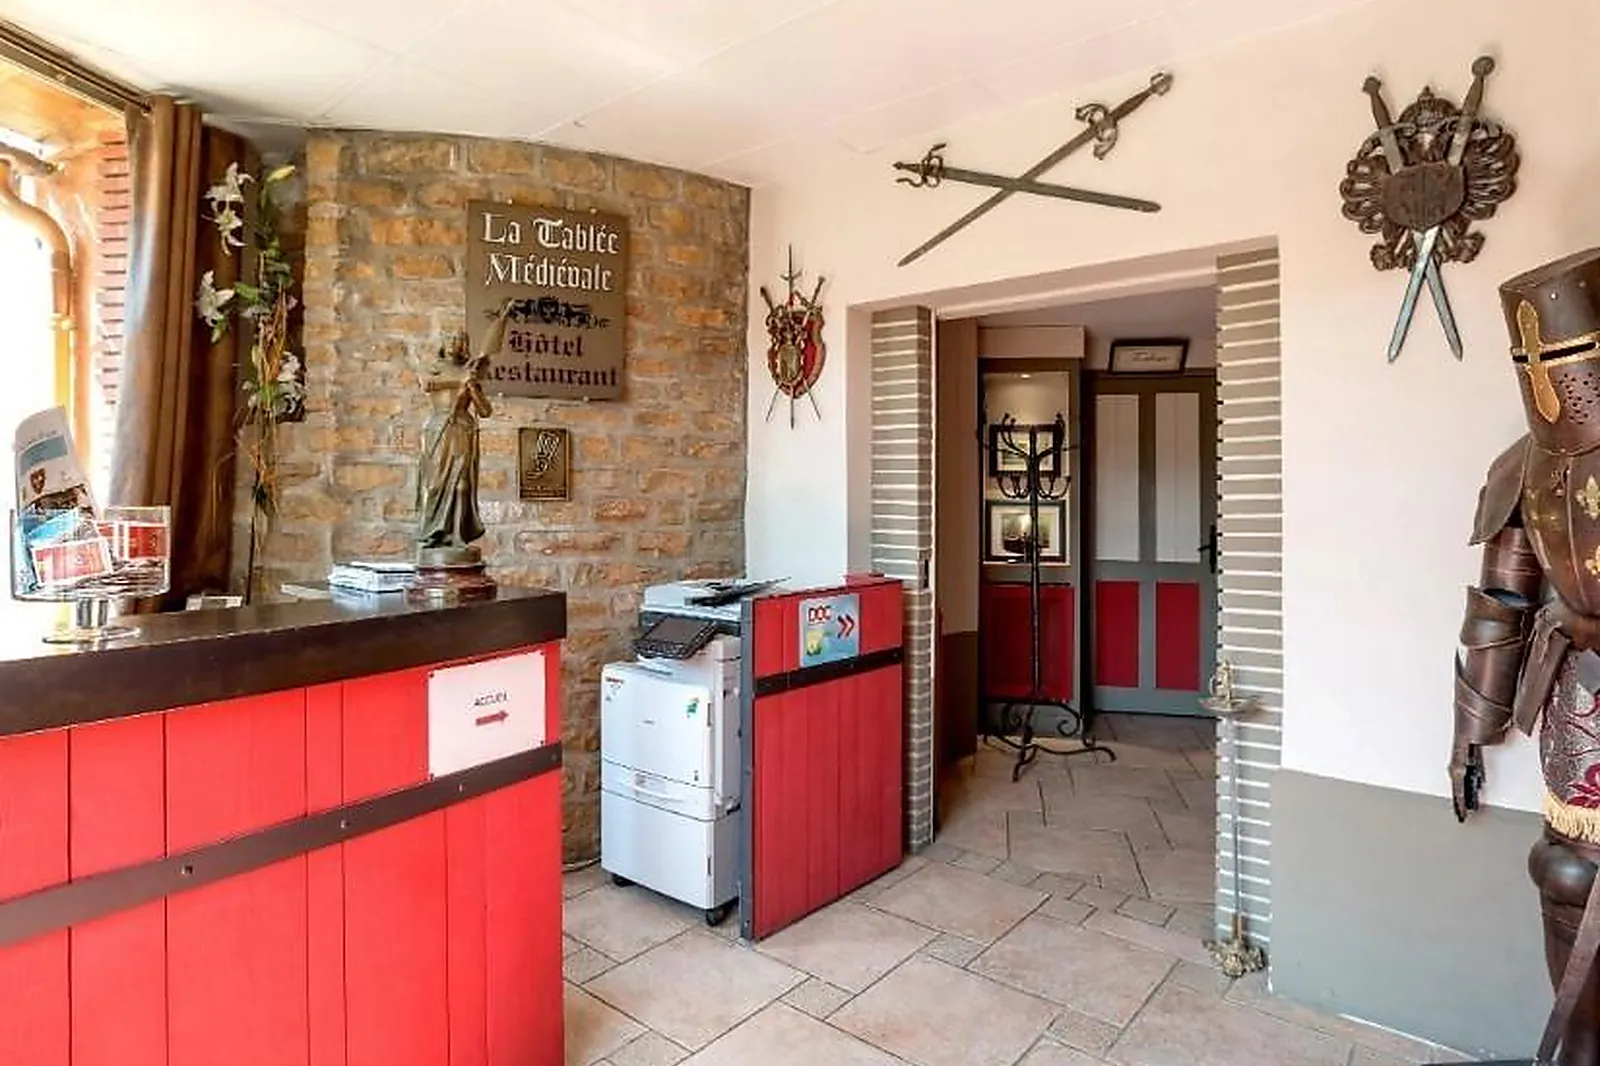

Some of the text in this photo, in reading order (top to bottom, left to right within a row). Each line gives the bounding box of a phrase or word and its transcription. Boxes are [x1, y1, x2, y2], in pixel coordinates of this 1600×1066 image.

[481, 212, 618, 253] La Tablée
[486, 254, 612, 290] Médiévale
[510, 330, 583, 357] Hôtel
